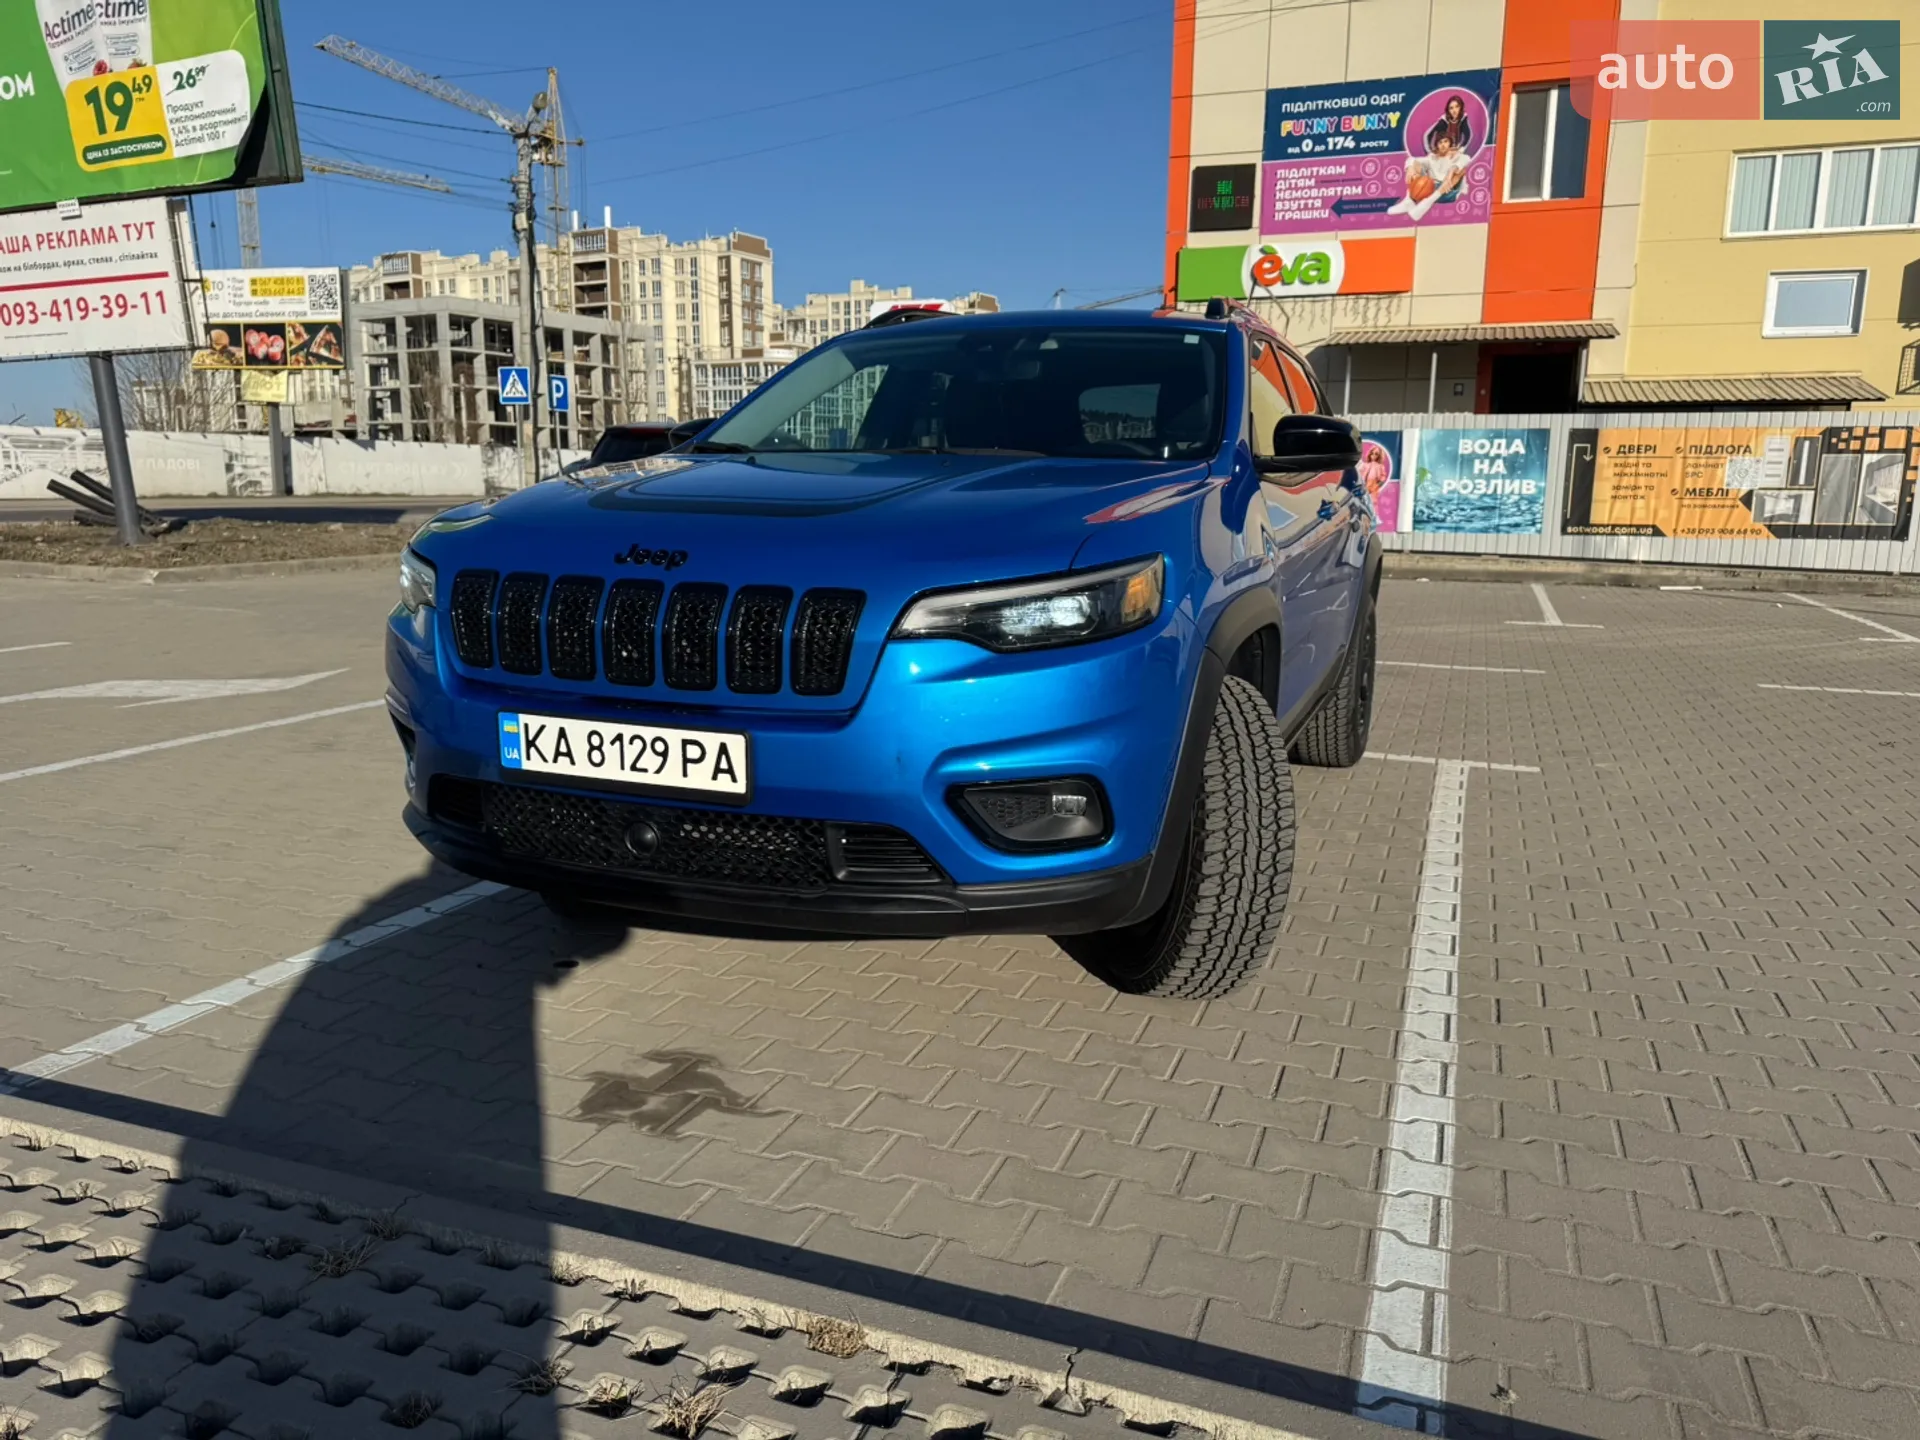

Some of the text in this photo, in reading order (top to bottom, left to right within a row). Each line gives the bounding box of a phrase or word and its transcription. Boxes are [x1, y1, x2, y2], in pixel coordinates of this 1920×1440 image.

[173, 68, 197, 91] 26
[84, 74, 153, 136] 19 49
[166, 101, 204, 114] Продукт
[1282, 93, 1406, 113] ПІДЛІТКОВИЙ ОДЯГ
[169, 103, 236, 124] кисломолочний
[1280, 111, 1401, 136] FUNNY BUNNY
[175, 133, 205, 148] Actimel
[206, 130, 220, 141] 100
[1301, 138, 1313, 152] 0
[1326, 135, 1356, 150] 174
[110, 140, 163, 155] ЗАСТОСУНКОМ
[1276, 165, 1347, 179] ПІДЛІТКАМ
[1275, 178, 1316, 190] ДІТЯМ
[1274, 199, 1323, 211] ВЗУТТЯ
[1273, 209, 1330, 221] ІГРАШКИ
[36, 225, 119, 251] РЕКЛАМА
[122, 221, 155, 242] ТУТ
[1, 290, 167, 326] 093-419-39-11
[551, 379, 564, 407] P
[1459, 438, 1526, 456] ВОДА
[1616, 444, 1657, 455] ДВЕРІ
[1689, 444, 1752, 456] ПІДЛОГА
[1474, 459, 1507, 475] НА
[1442, 479, 1537, 495] РОЗЛИВ
[1684, 488, 1729, 497] МЕБЛІ
[1566, 524, 1654, 535] sotwood.com.ua
[613, 543, 689, 571] Jeep
[504, 747, 519, 760] UA
[524, 723, 738, 783] KA 8129 PA
